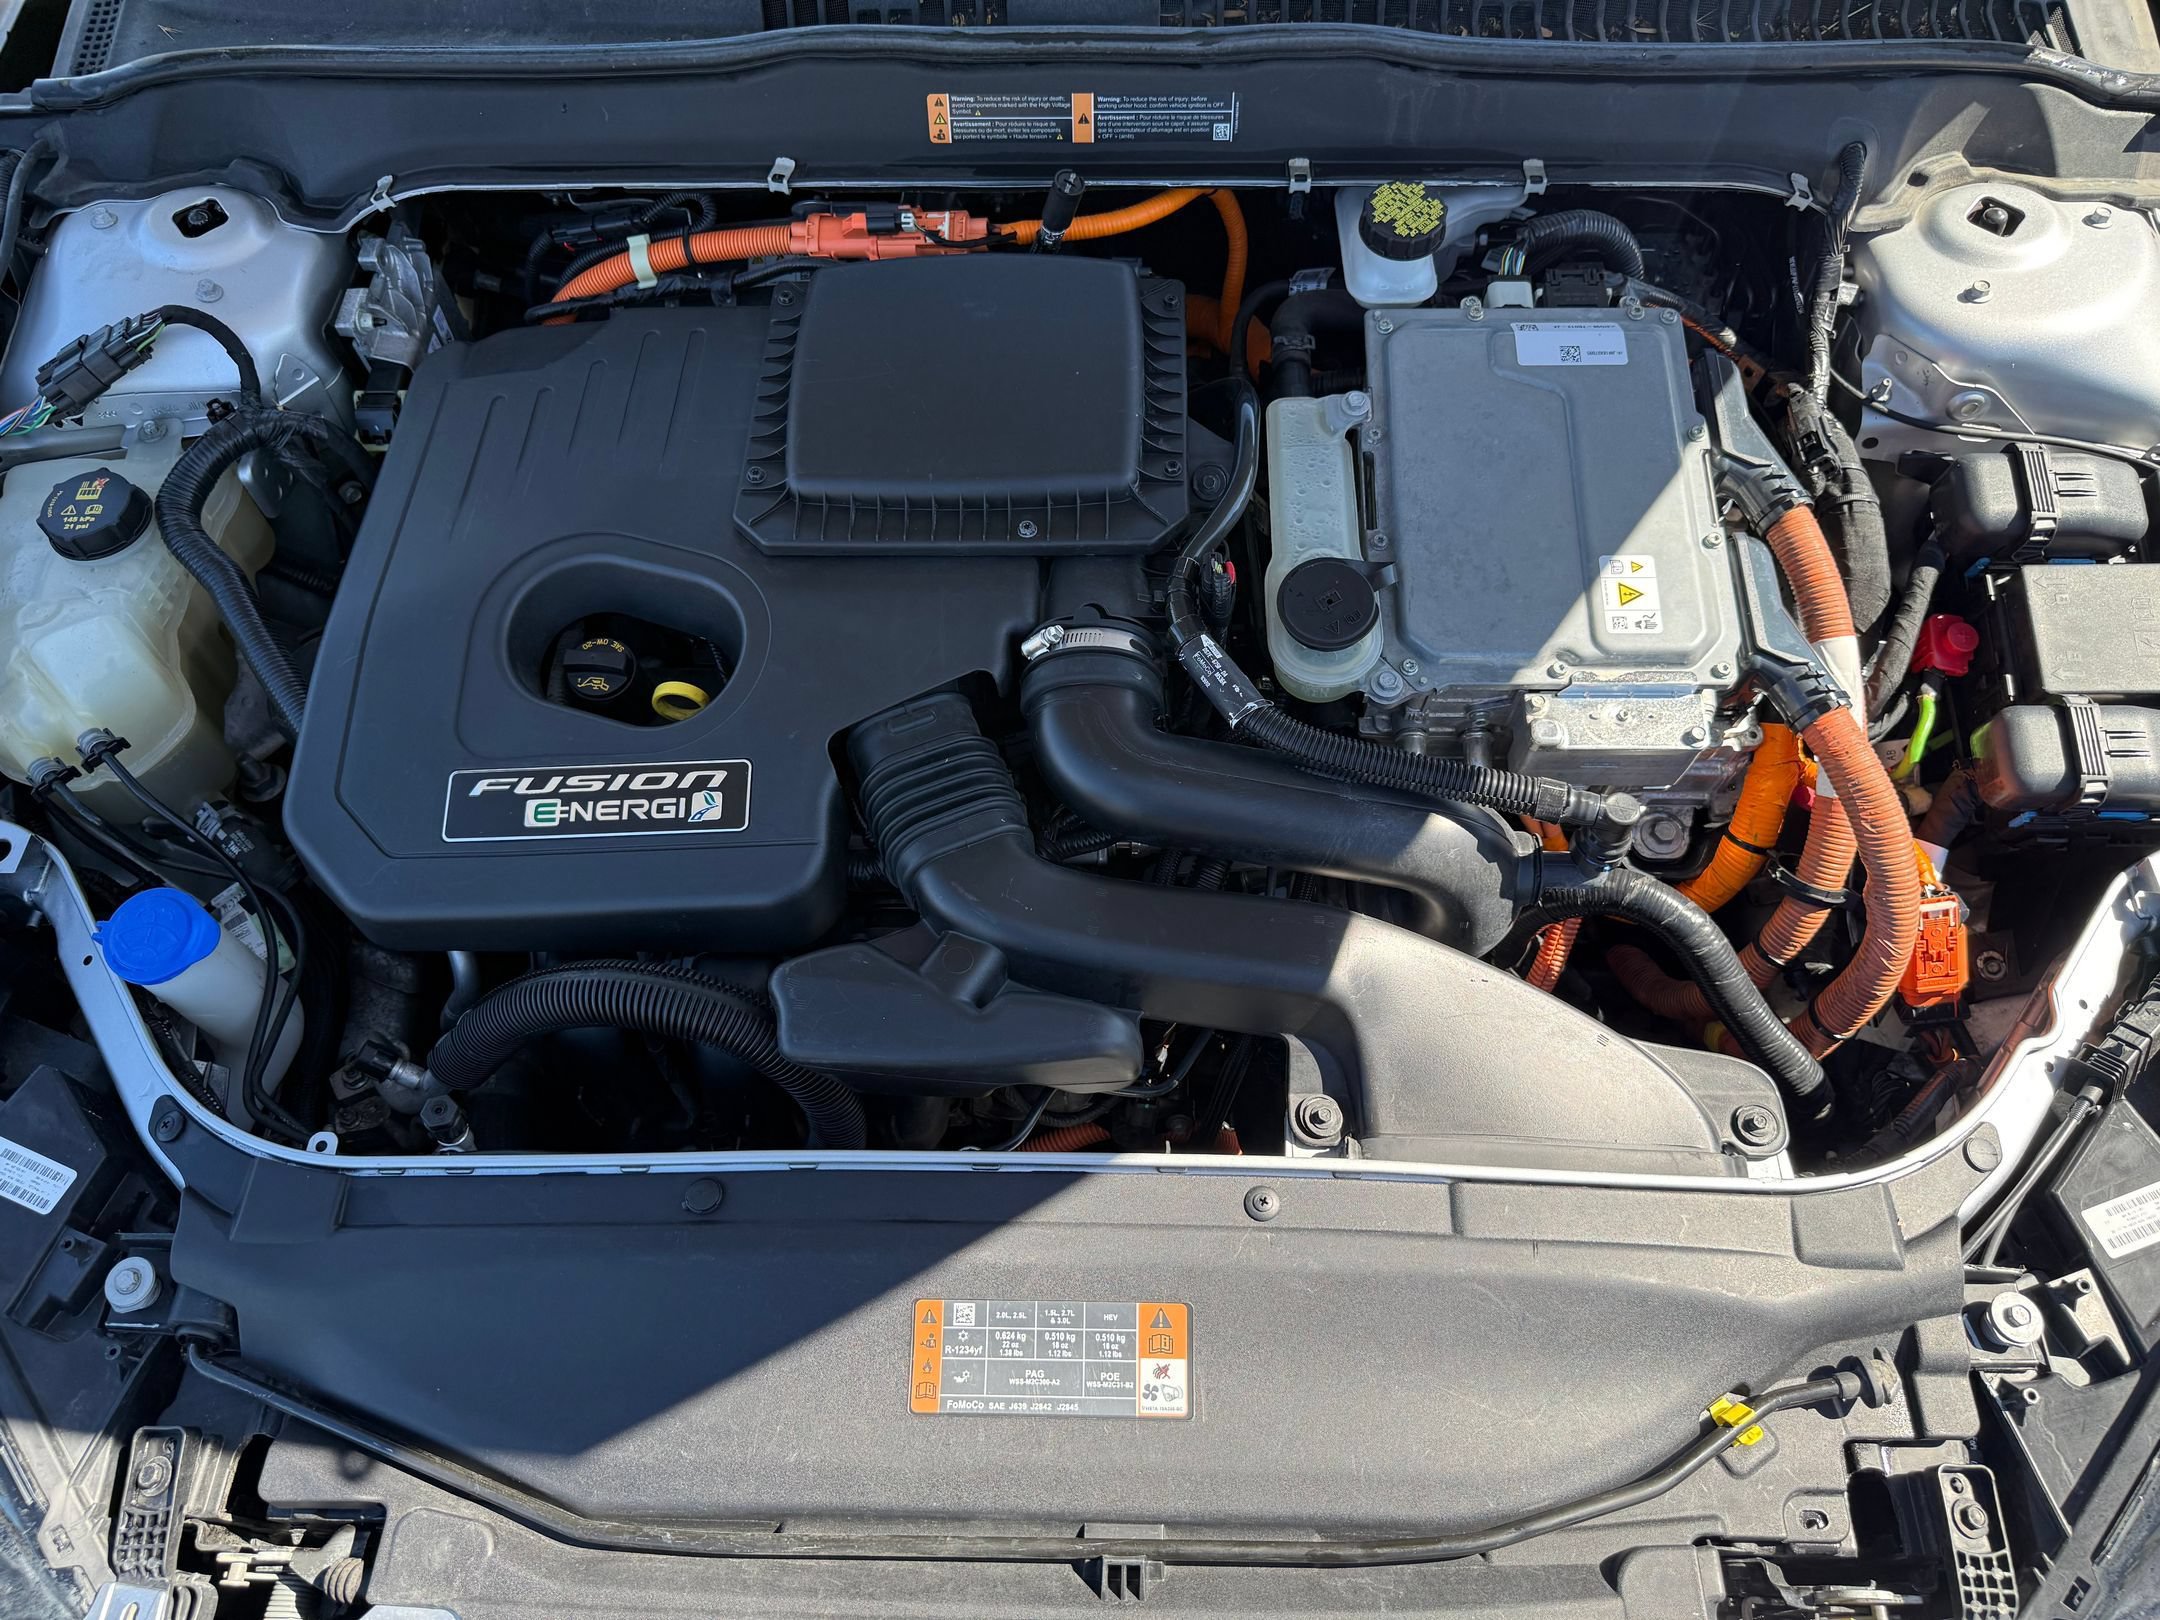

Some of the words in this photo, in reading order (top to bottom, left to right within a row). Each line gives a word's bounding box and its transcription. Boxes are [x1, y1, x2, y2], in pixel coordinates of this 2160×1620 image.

[582, 638, 609, 650] 0W-20
[611, 640, 625, 653] SAE
[1194, 652, 1212, 675] FoMoCo
[468, 769, 728, 797] FUSION
[525, 797, 687, 827] ENERGI
[1045, 1309, 1060, 1317] 1.5L,
[995, 1331, 1015, 1340] 0.624
[1017, 1331, 1026, 1342] kg
[1044, 1332, 1064, 1340] 0.510
[1066, 1332, 1076, 1343] kg
[1095, 1333, 1115, 1341] 0.510
[1116, 1333, 1126, 1344] kg
[945, 1345, 983, 1356] R-1234yf
[1099, 1350, 1111, 1358] 1.12
[1112, 1350, 1122, 1358] lbs
[1025, 1369, 1045, 1378] PAG
[1100, 1372, 1120, 1381] POE
[947, 1400, 984, 1410] FoMoCo
[988, 1402, 1005, 1410] SAE
[1008, 1402, 1027, 1410] J639
[1030, 1402, 1052, 1411] J2842
[1057, 1403, 1079, 1411] J2845
